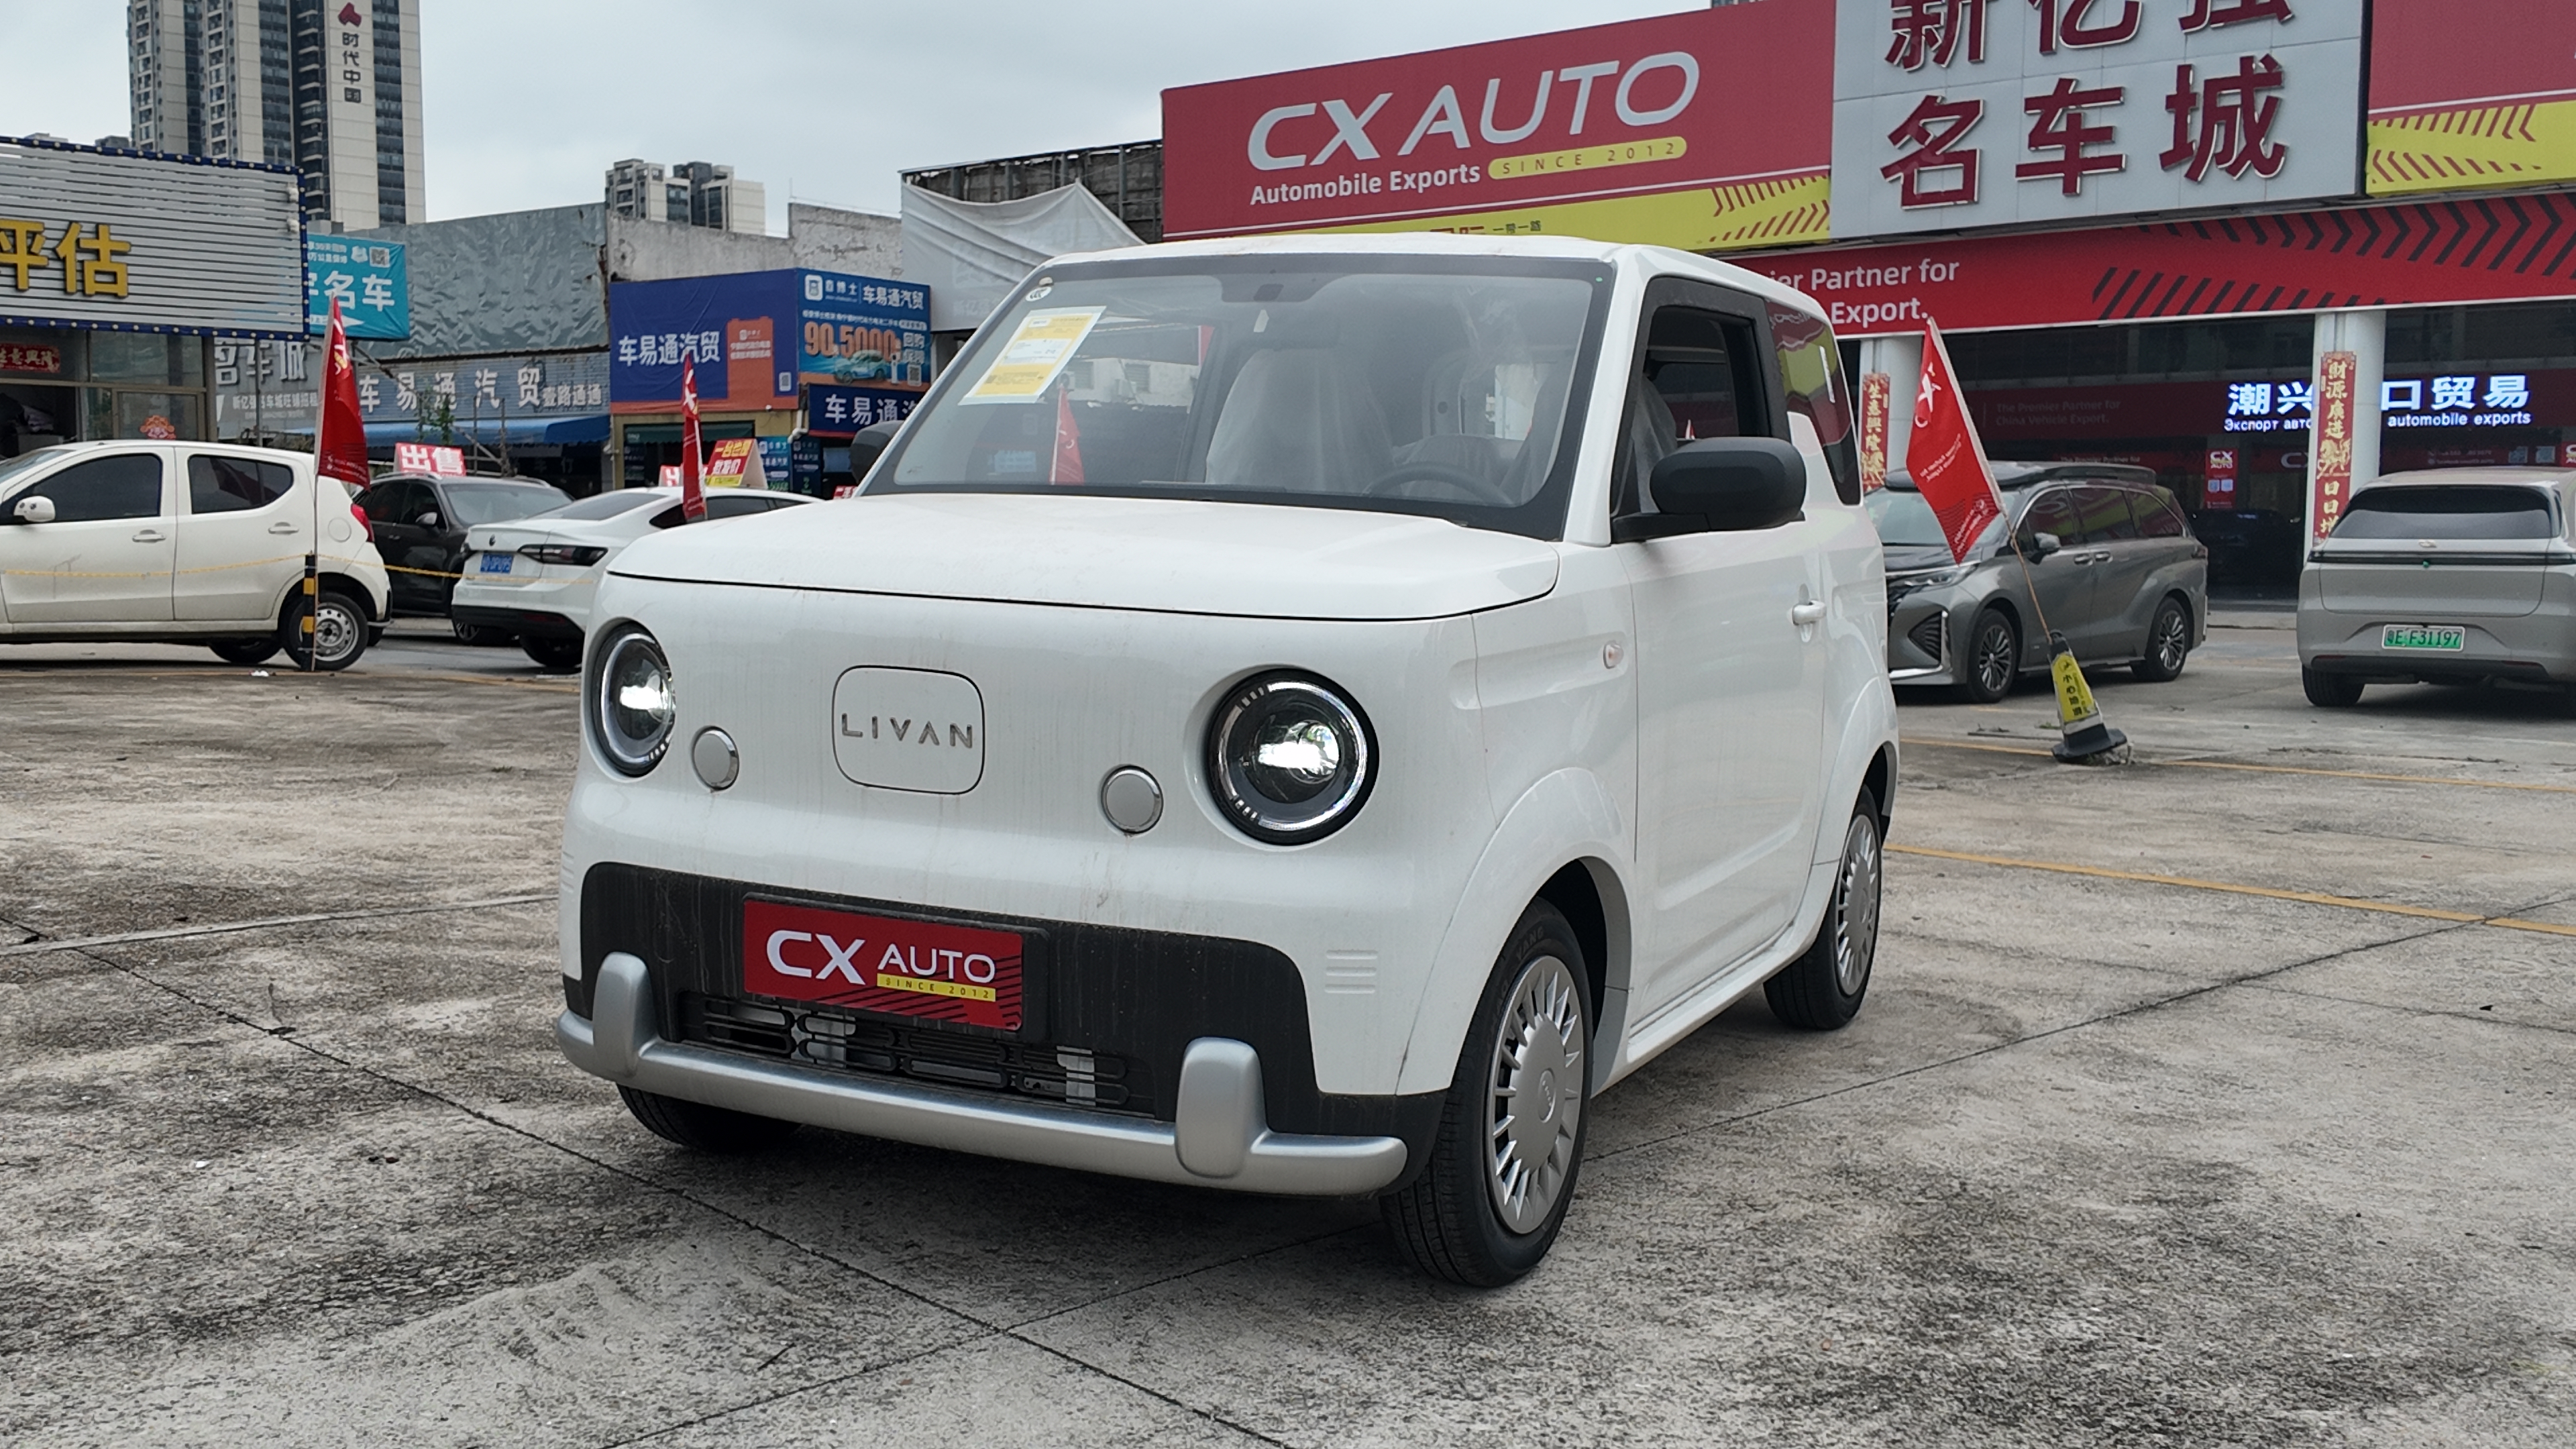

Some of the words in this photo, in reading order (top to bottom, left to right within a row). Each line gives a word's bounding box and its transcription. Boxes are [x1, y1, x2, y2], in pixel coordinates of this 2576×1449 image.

[342, 32, 361, 103] 时代中国
[1248, 93, 1393, 170] CX
[1397, 52, 1699, 156] AUTO
[1880, 54, 2289, 209] 名车城
[1503, 154, 1582, 174] SINCE
[1607, 143, 1674, 162] 2012
[1250, 172, 1382, 205] Automobile
[1390, 164, 1481, 193] Exports
[1811, 266, 1911, 290] Partner
[1919, 258, 1960, 283] for
[863, 284, 924, 310] 车易通汽贸
[1831, 297, 1929, 328] Export.
[618, 331, 720, 366] 车易通汽贸
[359, 366, 540, 413] 车易通汽贸
[2224, 418, 2279, 432] Экспорт
[2388, 412, 2468, 427] automobile
[2474, 411, 2532, 427] exports
[400, 445, 463, 474] 出售
[2282, 452, 2308, 468] C
[841, 713, 973, 749] LIVAN
[767, 930, 866, 985] CX
[878, 943, 996, 983] AUTO
[885, 977, 935, 992] SINCE
[949, 985, 989, 1000] 2012
